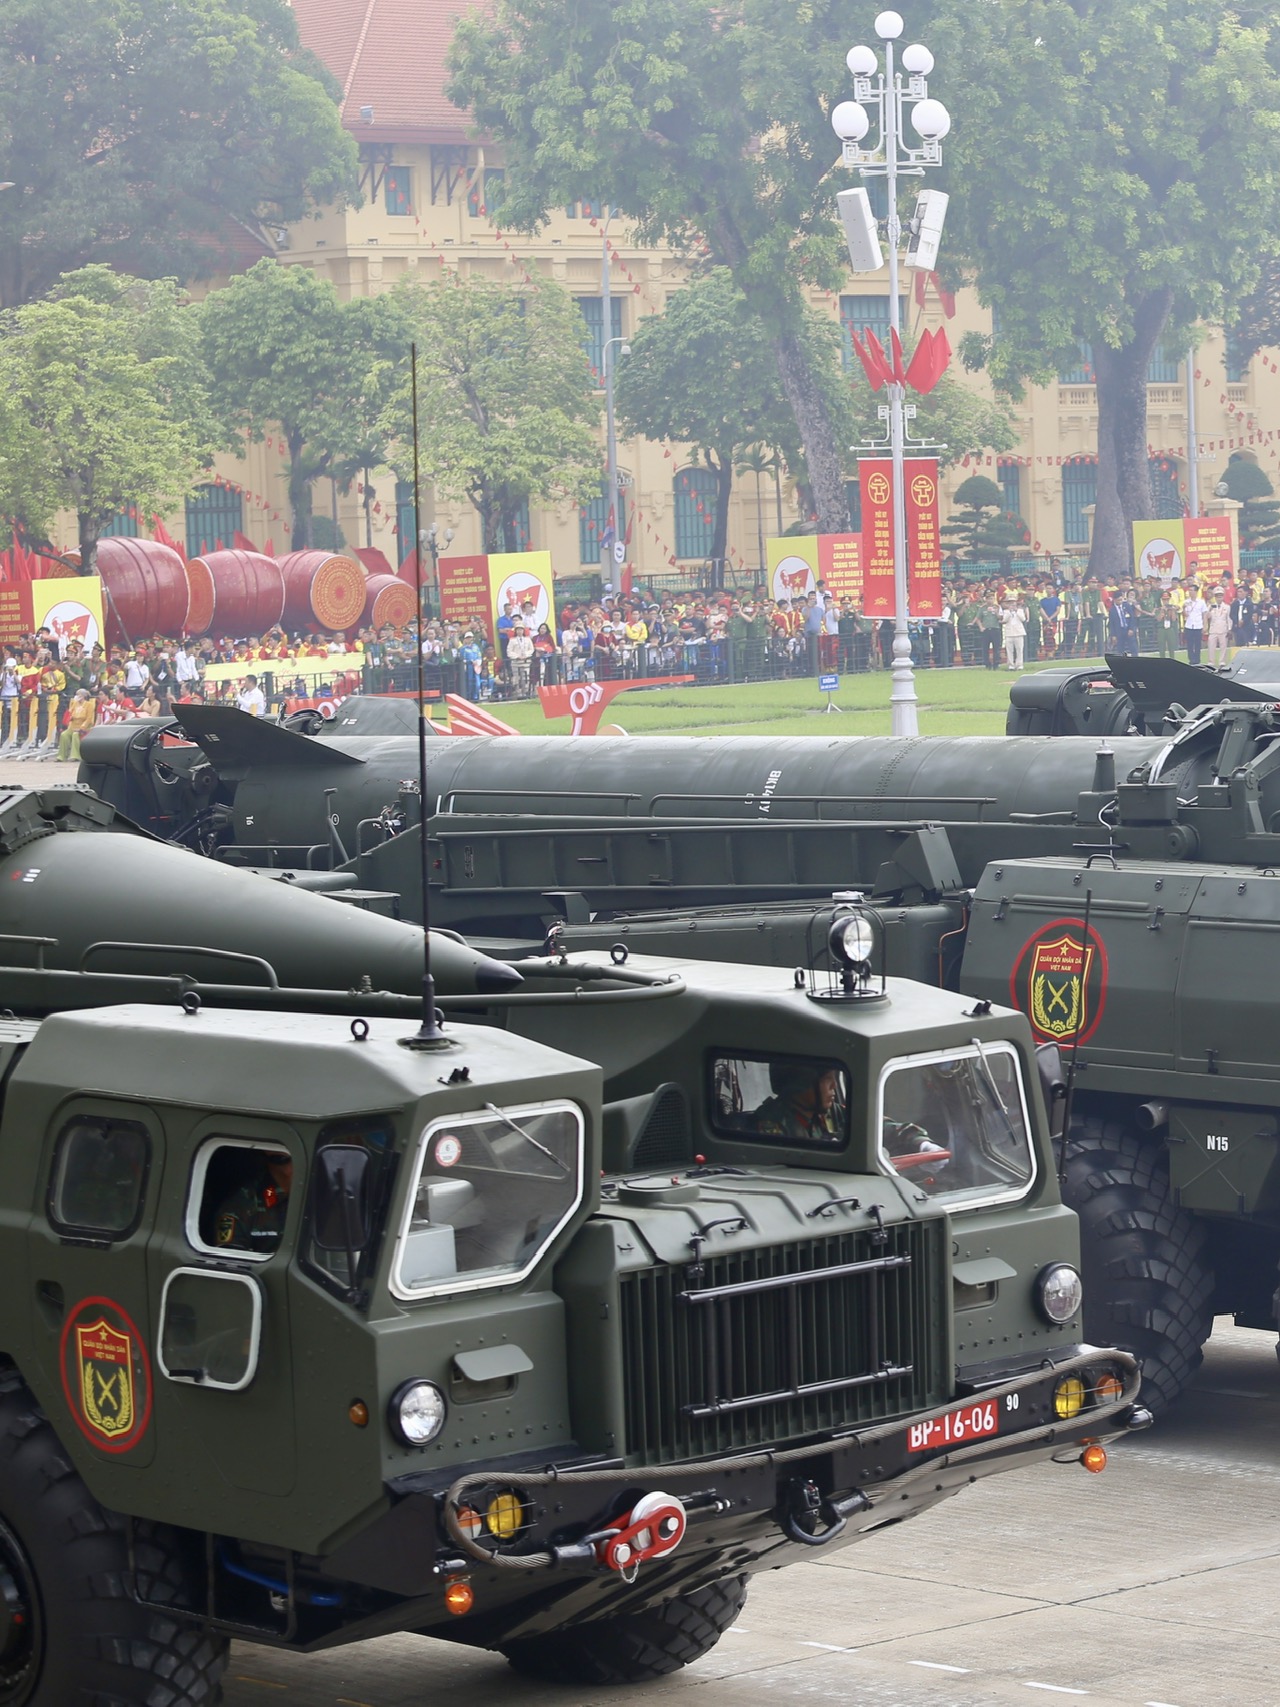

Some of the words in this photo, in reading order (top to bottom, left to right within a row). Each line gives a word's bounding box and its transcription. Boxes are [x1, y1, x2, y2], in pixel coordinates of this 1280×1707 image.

[1207, 1135, 1228, 1151] N15
[1006, 1394, 1019, 1411] 90
[910, 1404, 994, 1448] BP-16-06
